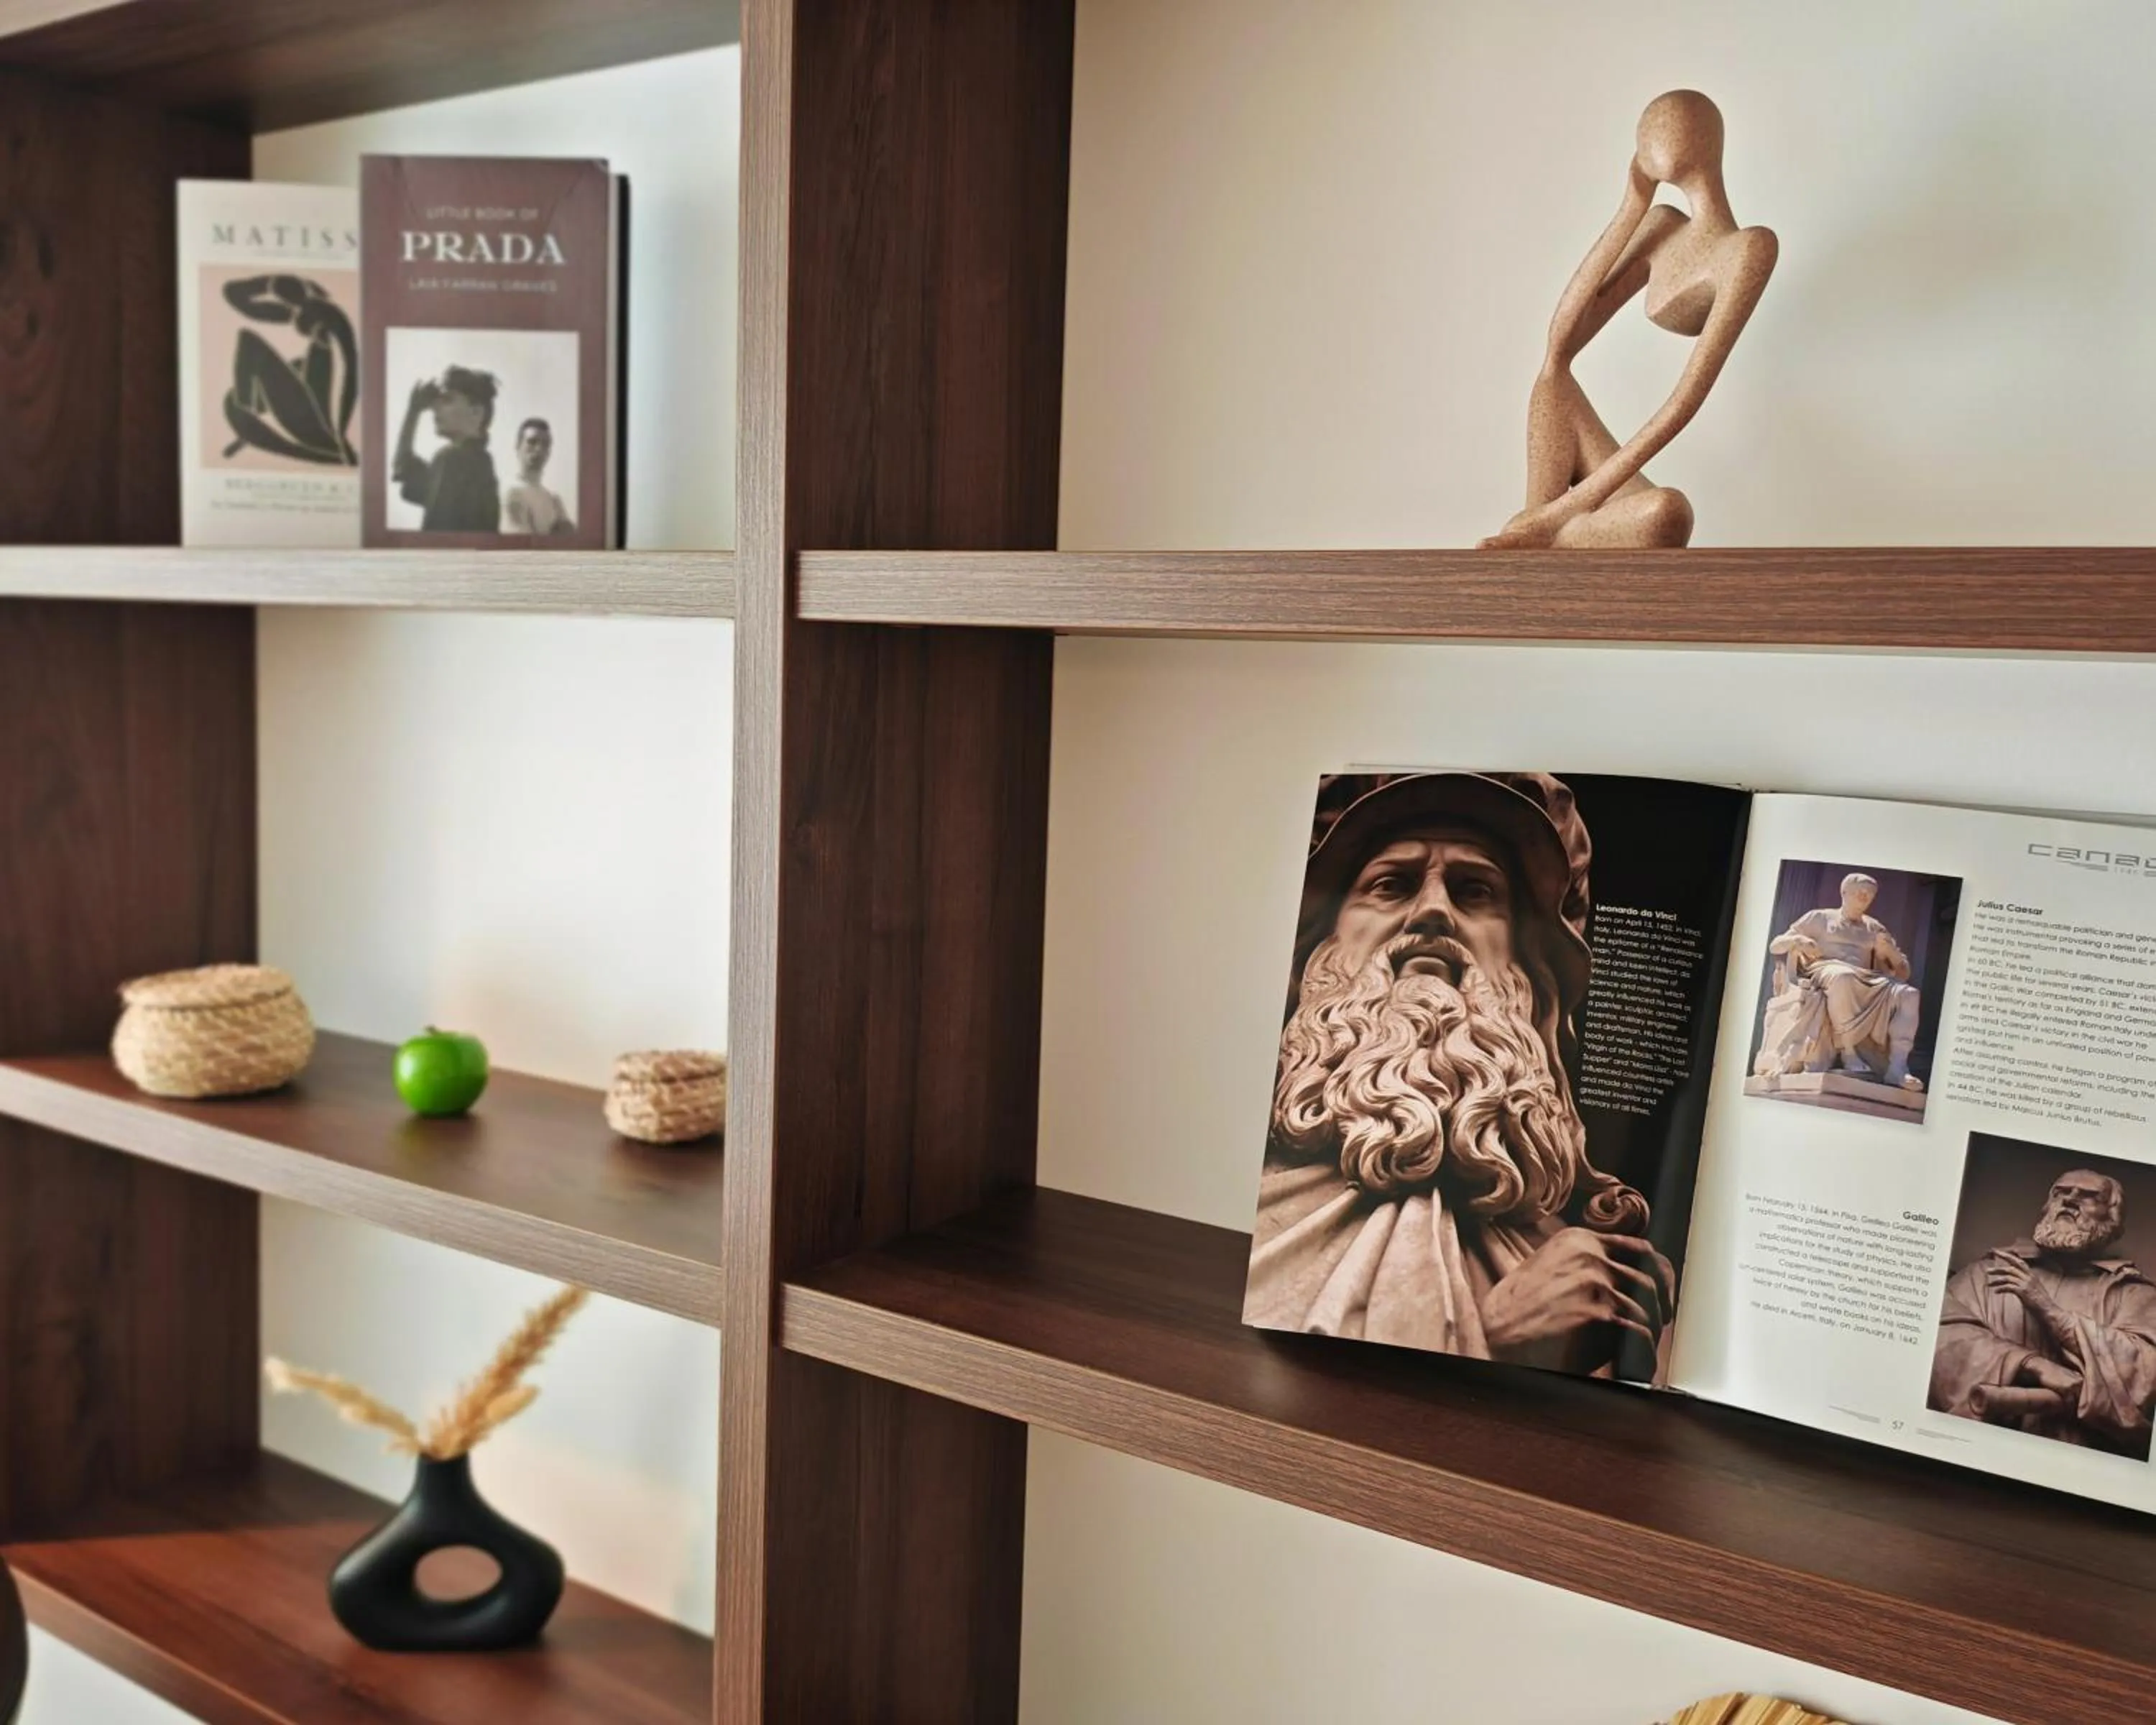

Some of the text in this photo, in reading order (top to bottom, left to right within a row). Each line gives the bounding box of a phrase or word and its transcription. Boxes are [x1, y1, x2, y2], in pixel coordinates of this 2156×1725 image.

[400, 230, 567, 265] PRADA
[1596, 903, 1639, 916] Leonardo
[1655, 911, 1677, 921] Vinci
[2006, 903, 2043, 915] Caesar
[1902, 1211, 1939, 1225] Galileo
